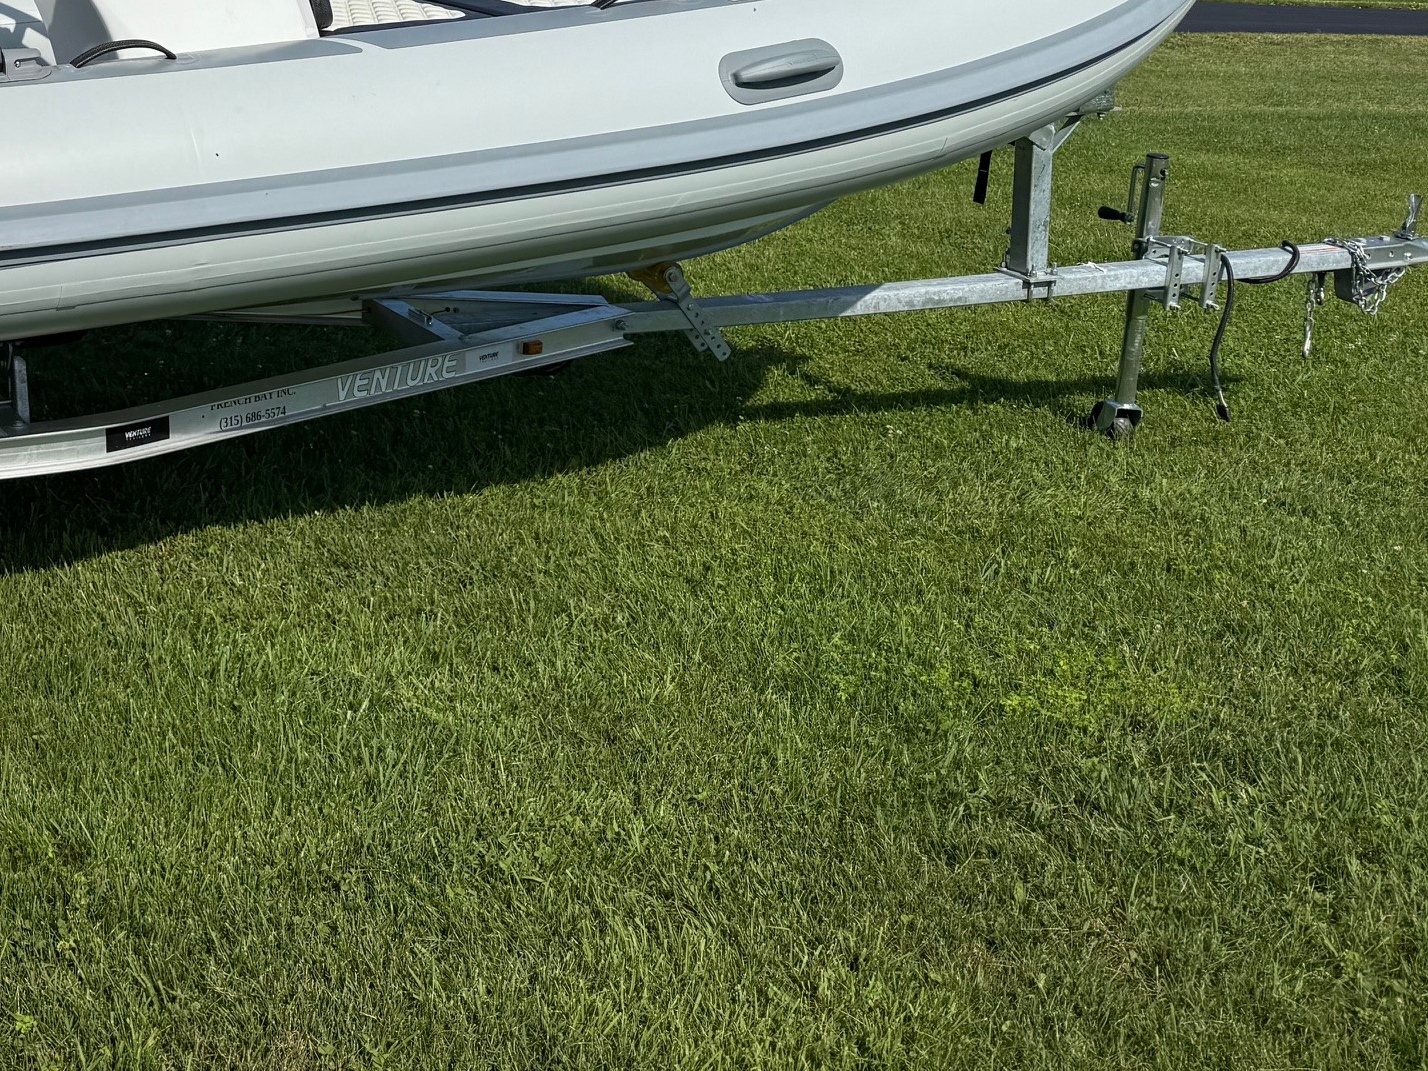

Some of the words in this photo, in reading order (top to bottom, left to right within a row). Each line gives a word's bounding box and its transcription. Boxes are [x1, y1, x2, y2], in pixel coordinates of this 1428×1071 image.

[337, 353, 458, 401] VENTURE
[220, 414, 243, 431] (315)
[246, 406, 286, 423] 686-5574
